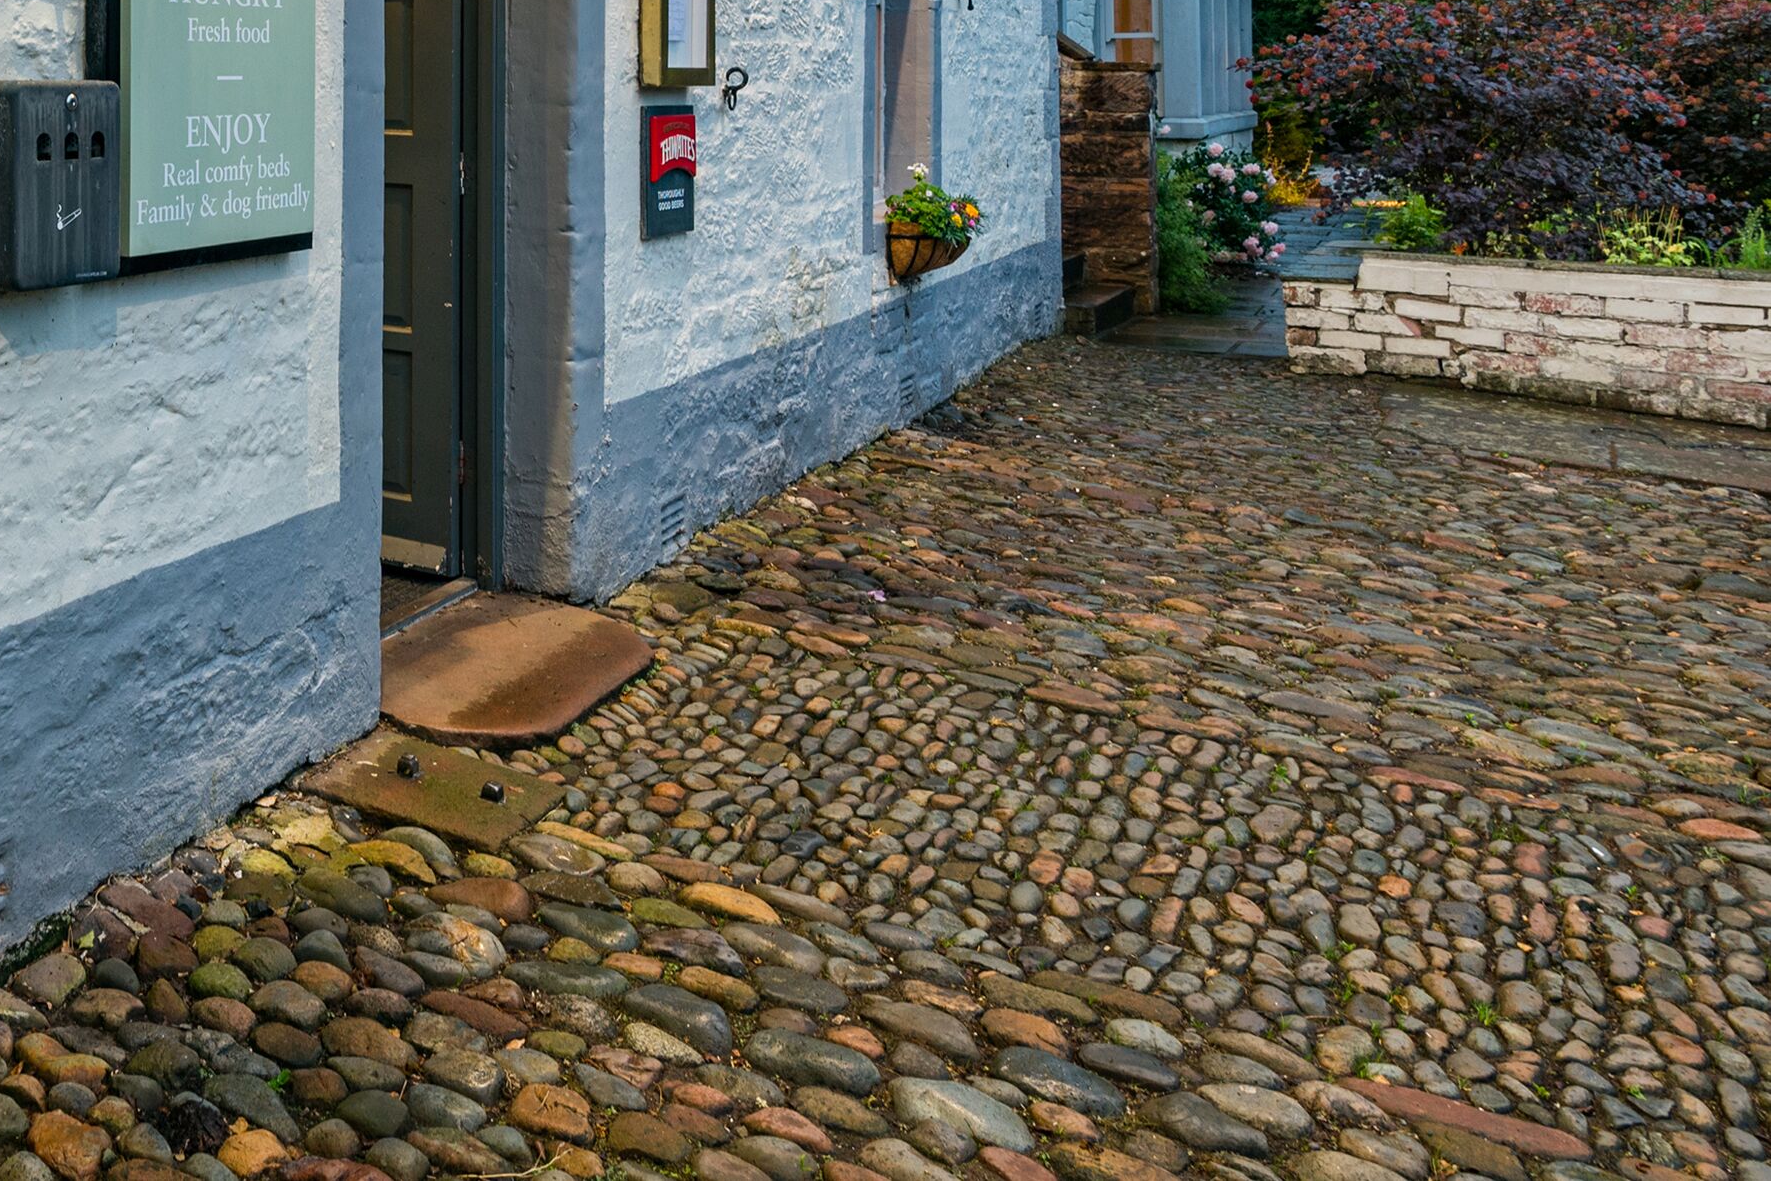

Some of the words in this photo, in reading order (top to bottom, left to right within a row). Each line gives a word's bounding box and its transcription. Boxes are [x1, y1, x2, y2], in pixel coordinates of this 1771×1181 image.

[188, 18, 230, 42] Fresh
[236, 18, 270, 43] food
[186, 113, 271, 154] ENJOY
[660, 134, 695, 165] THWAITES
[162, 159, 200, 187] Real
[205, 155, 253, 186] comfy
[257, 152, 290, 179] beds
[136, 195, 195, 226] Family
[200, 194, 218, 217] &
[222, 189, 251, 219] dog
[256, 182, 310, 212] friendly
[658, 201, 671, 211] GOOD
